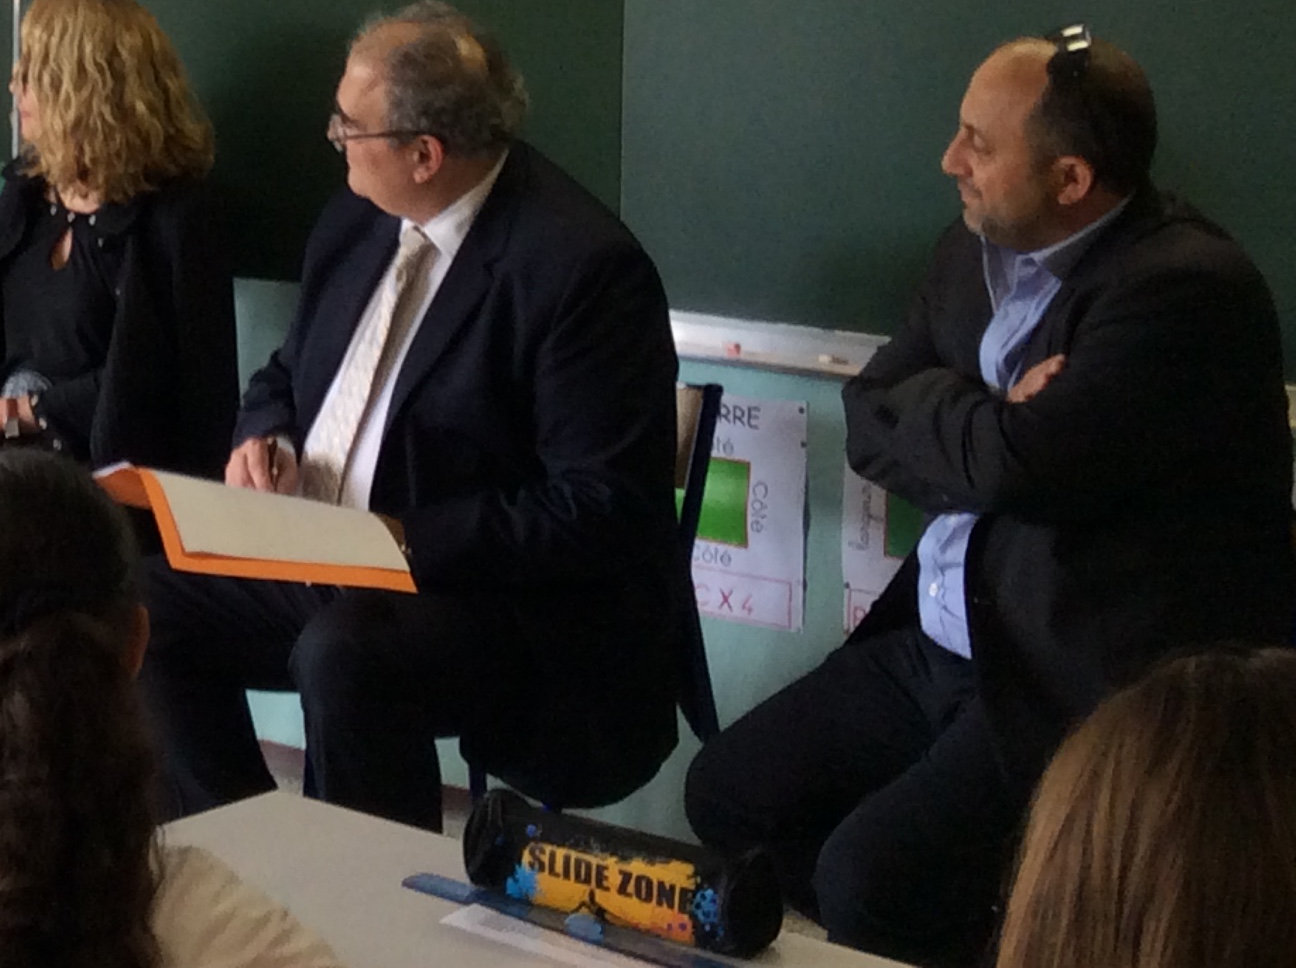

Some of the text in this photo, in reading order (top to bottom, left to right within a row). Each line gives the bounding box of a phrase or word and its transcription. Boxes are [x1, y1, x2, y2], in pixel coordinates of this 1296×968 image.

[718, 403, 761, 430] RRE
[742, 594, 753, 616] 4
[528, 842, 695, 914] SLIDE ZONE
